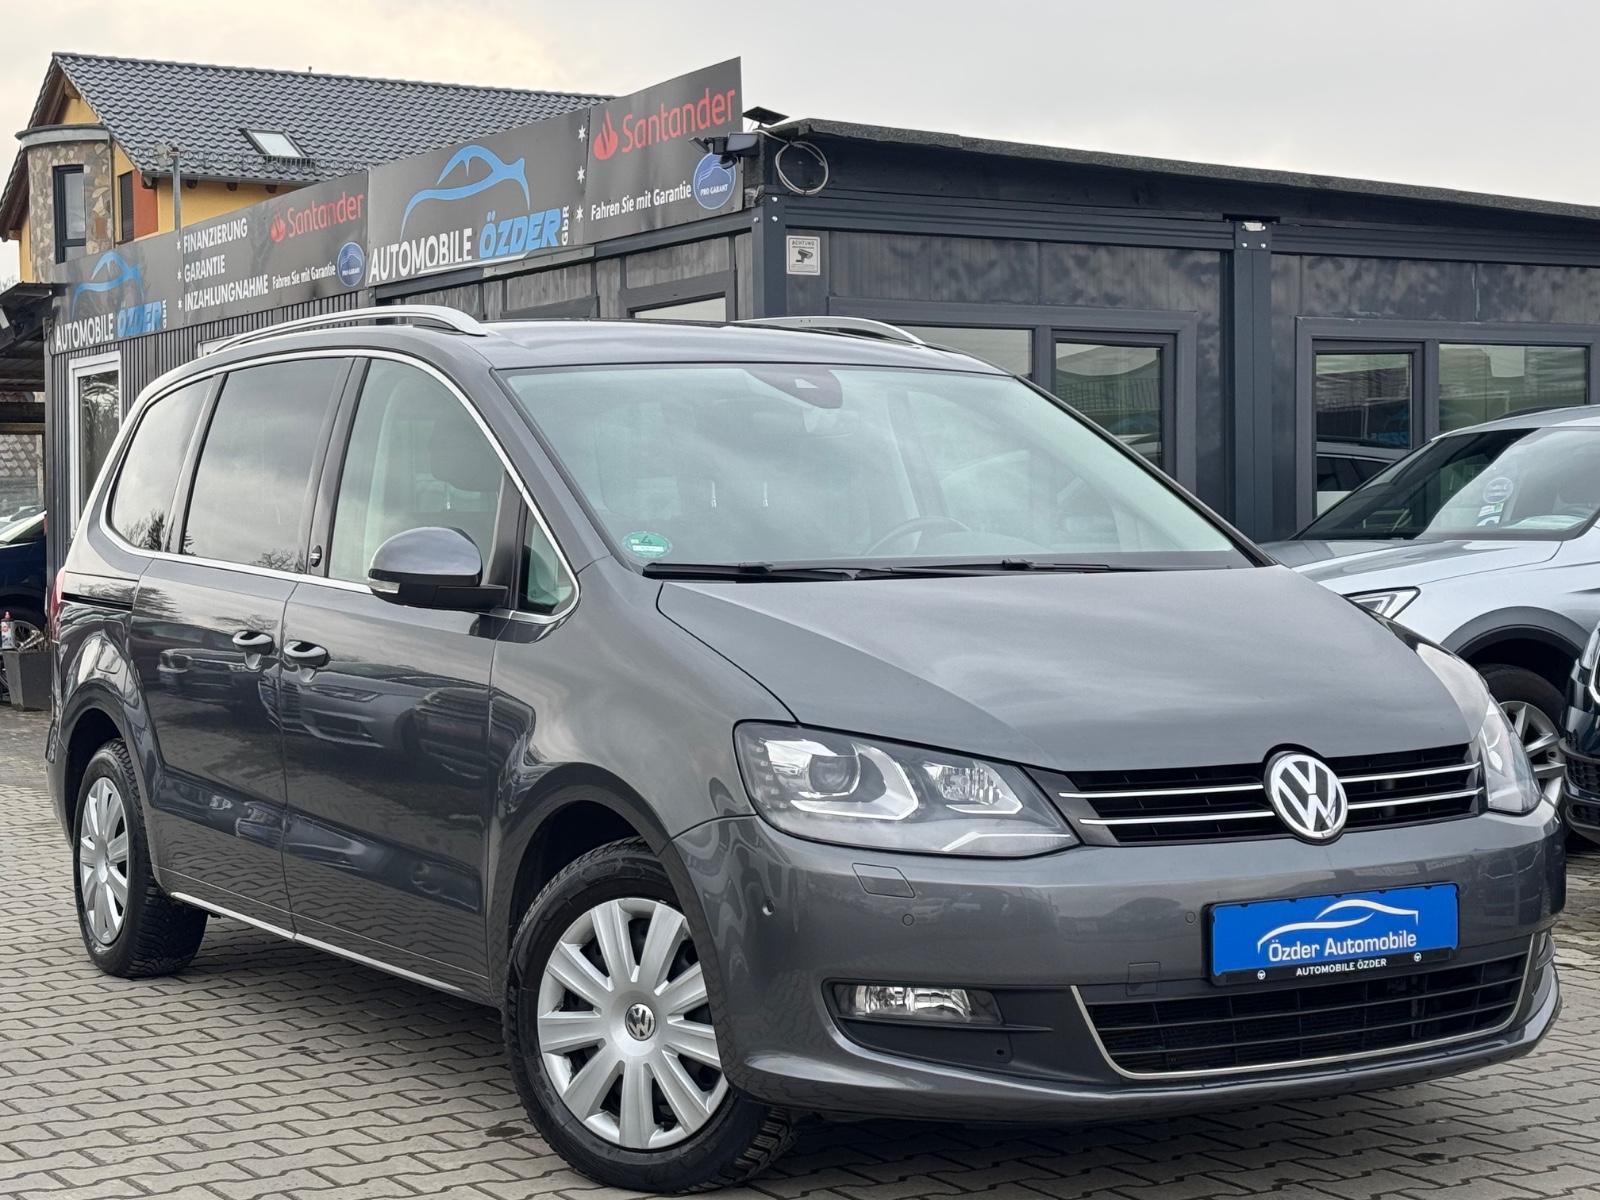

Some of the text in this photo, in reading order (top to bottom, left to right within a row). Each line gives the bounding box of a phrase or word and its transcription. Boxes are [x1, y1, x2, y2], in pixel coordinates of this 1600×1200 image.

[621, 88, 735, 153] Santander
[287, 191, 365, 238] Santander
[591, 180, 692, 221] Fahren Sie mit Garantie
[183, 217, 248, 254] FINANZIERUNG
[561, 205, 570, 246] GbR
[368, 210, 562, 283] AUTOMOBILE ÖZDER
[184, 254, 226, 283] GARANTIE
[272, 274, 291, 290] Fahren
[291, 269, 301, 285] Sie
[310, 260, 336, 281] Garantie
[184, 274, 269, 312] INZAHLUNGNAHME
[55, 312, 114, 353] AUTOMOBILE
[1268, 929, 1417, 962] Özder Automobile
[1296, 957, 1388, 977] AUTOMOBILE ÖZDER
